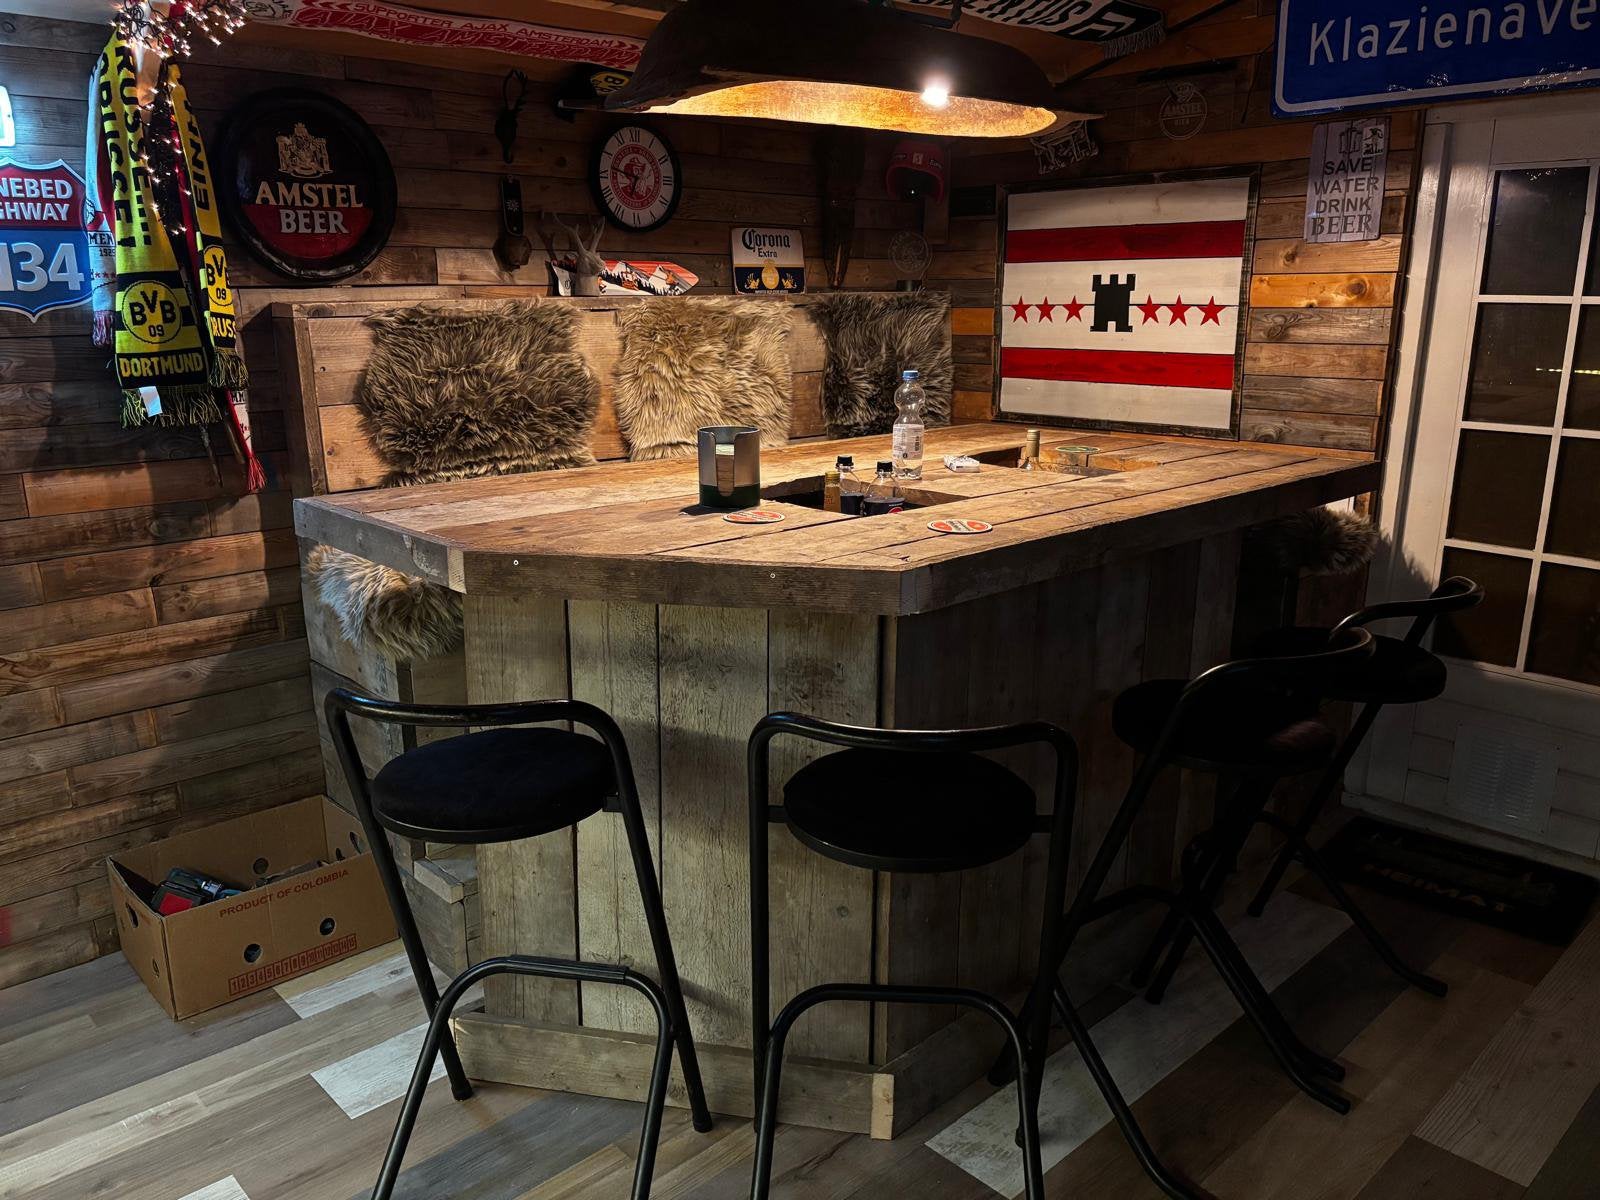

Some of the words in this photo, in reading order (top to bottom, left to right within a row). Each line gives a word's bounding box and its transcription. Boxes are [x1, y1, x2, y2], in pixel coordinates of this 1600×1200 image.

[356, 4, 452, 27] SUPPORTER
[461, 22, 508, 33] AJAX
[516, 28, 613, 47] AMSTERDAM
[1324, 157, 1373, 175] SAVE
[255, 180, 364, 208] AMSTEL
[1314, 177, 1379, 195] WATER
[1316, 197, 1372, 214] DRINK
[279, 209, 351, 234] BEER
[1311, 214, 1373, 236] BEER
[741, 229, 791, 252] Corona
[757, 247, 778, 258] Extra
[215, 287, 227, 300] 09
[129, 290, 176, 326] BVB
[148, 324, 165, 337] 09
[119, 352, 205, 379] DORTMUND
[219, 893, 273, 918] PRODUCT
[277, 888, 292, 899] OF
[294, 869, 349, 893] COLOMBIA
